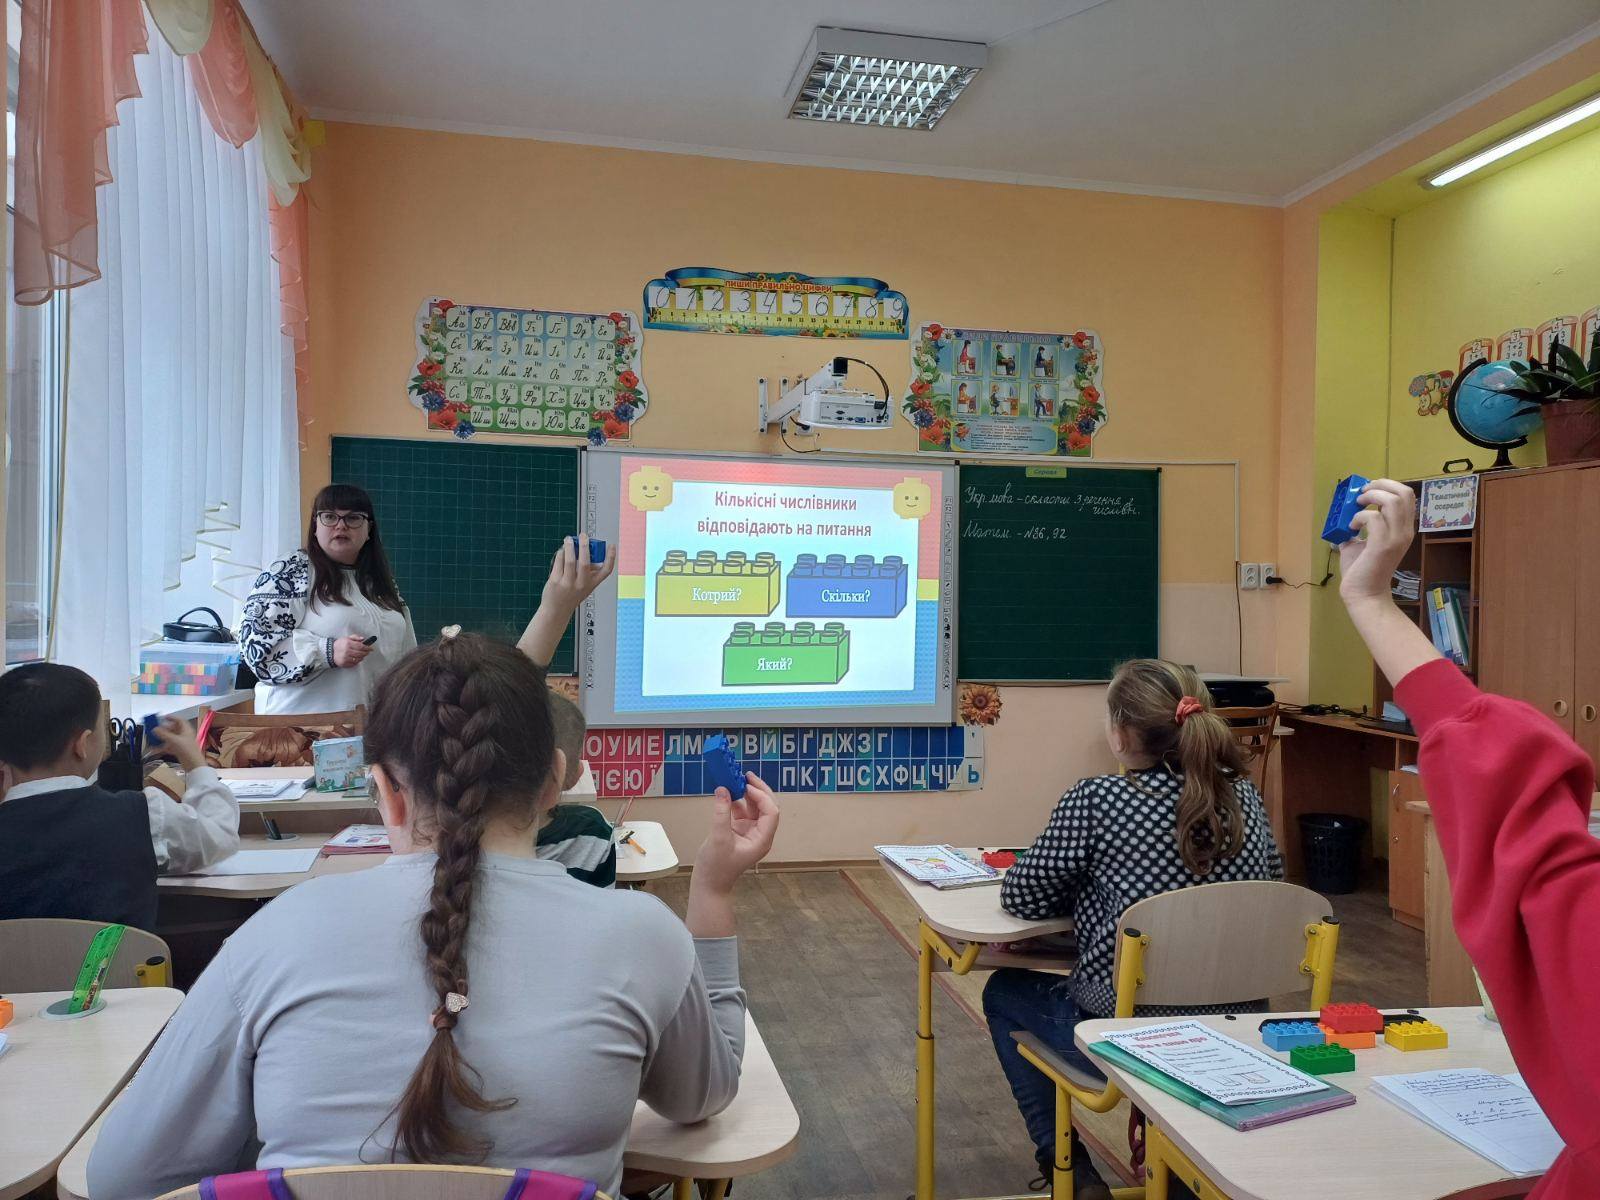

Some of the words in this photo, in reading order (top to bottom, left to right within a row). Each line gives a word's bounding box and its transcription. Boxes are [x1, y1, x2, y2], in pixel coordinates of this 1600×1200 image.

[725, 280, 750, 289] ПИШИ
[751, 281, 801, 291] ПРАВИЛЬНО
[803, 284, 832, 293] ЦИФРИ
[656, 287, 670, 308] 0
[687, 288, 697, 310] 1
[711, 289, 724, 311] 2
[737, 290, 751, 312] 3
[763, 291, 777, 314] 4
[789, 293, 803, 315] 5
[815, 294, 829, 316] 6
[842, 296, 854, 317] 7
[865, 298, 879, 319] 8
[890, 298, 903, 319] 9
[714, 490, 776, 509] Кількісні
[780, 494, 857, 511] числівники
[1024, 493, 1070, 505] скласти
[697, 516, 793, 537] відповідають
[797, 523, 812, 535] на
[817, 523, 872, 537] питання
[691, 587, 742, 605] Котрий?
[821, 588, 871, 603] Скільки?
[757, 657, 793, 671] Який?
